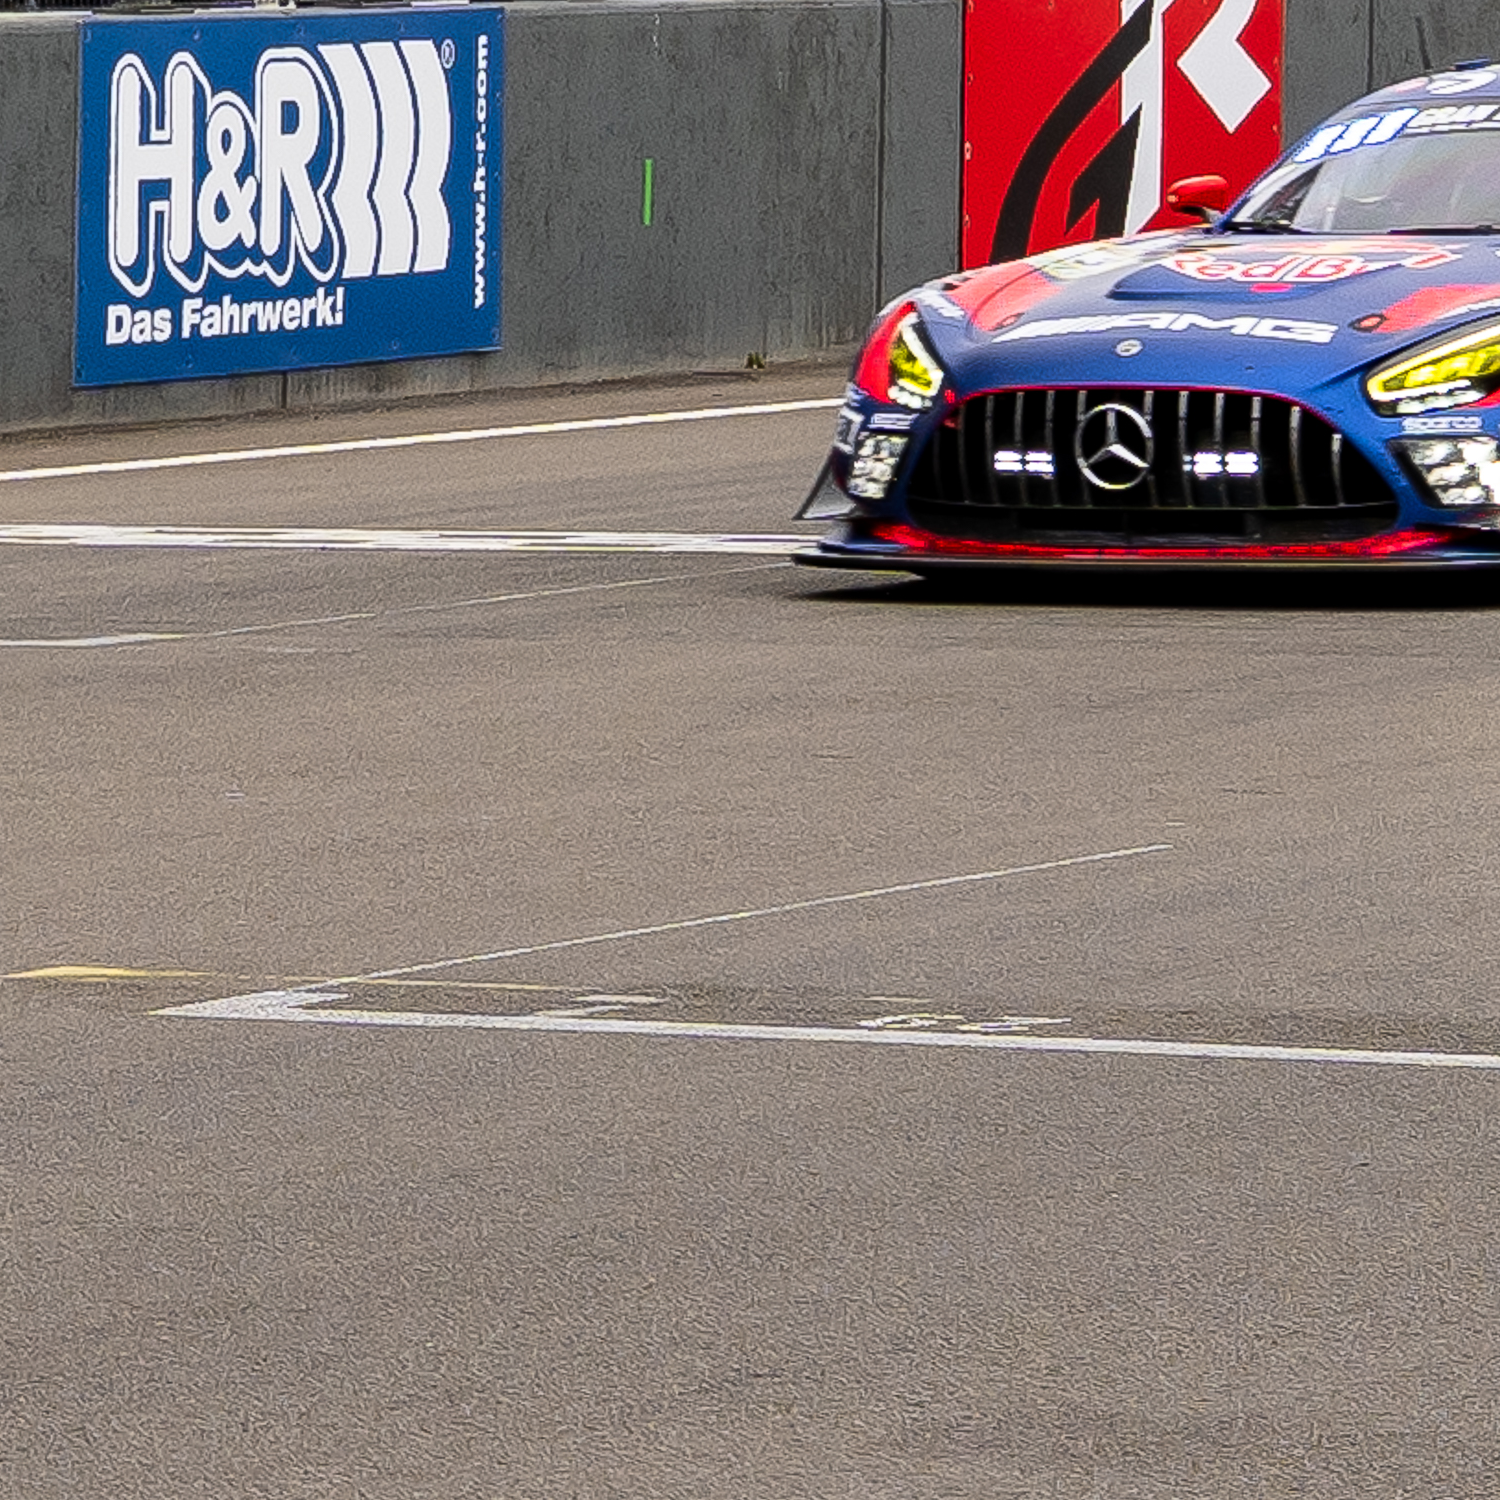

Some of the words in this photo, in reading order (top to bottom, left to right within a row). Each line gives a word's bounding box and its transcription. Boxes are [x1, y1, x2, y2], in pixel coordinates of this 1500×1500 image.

[108, 46, 340, 298] H&R
[473, 34, 489, 309] www.h-r.com
[105, 303, 173, 346] Das
[180, 285, 346, 340] Fahrwerk!
[1107, 311, 1338, 345] AMG
